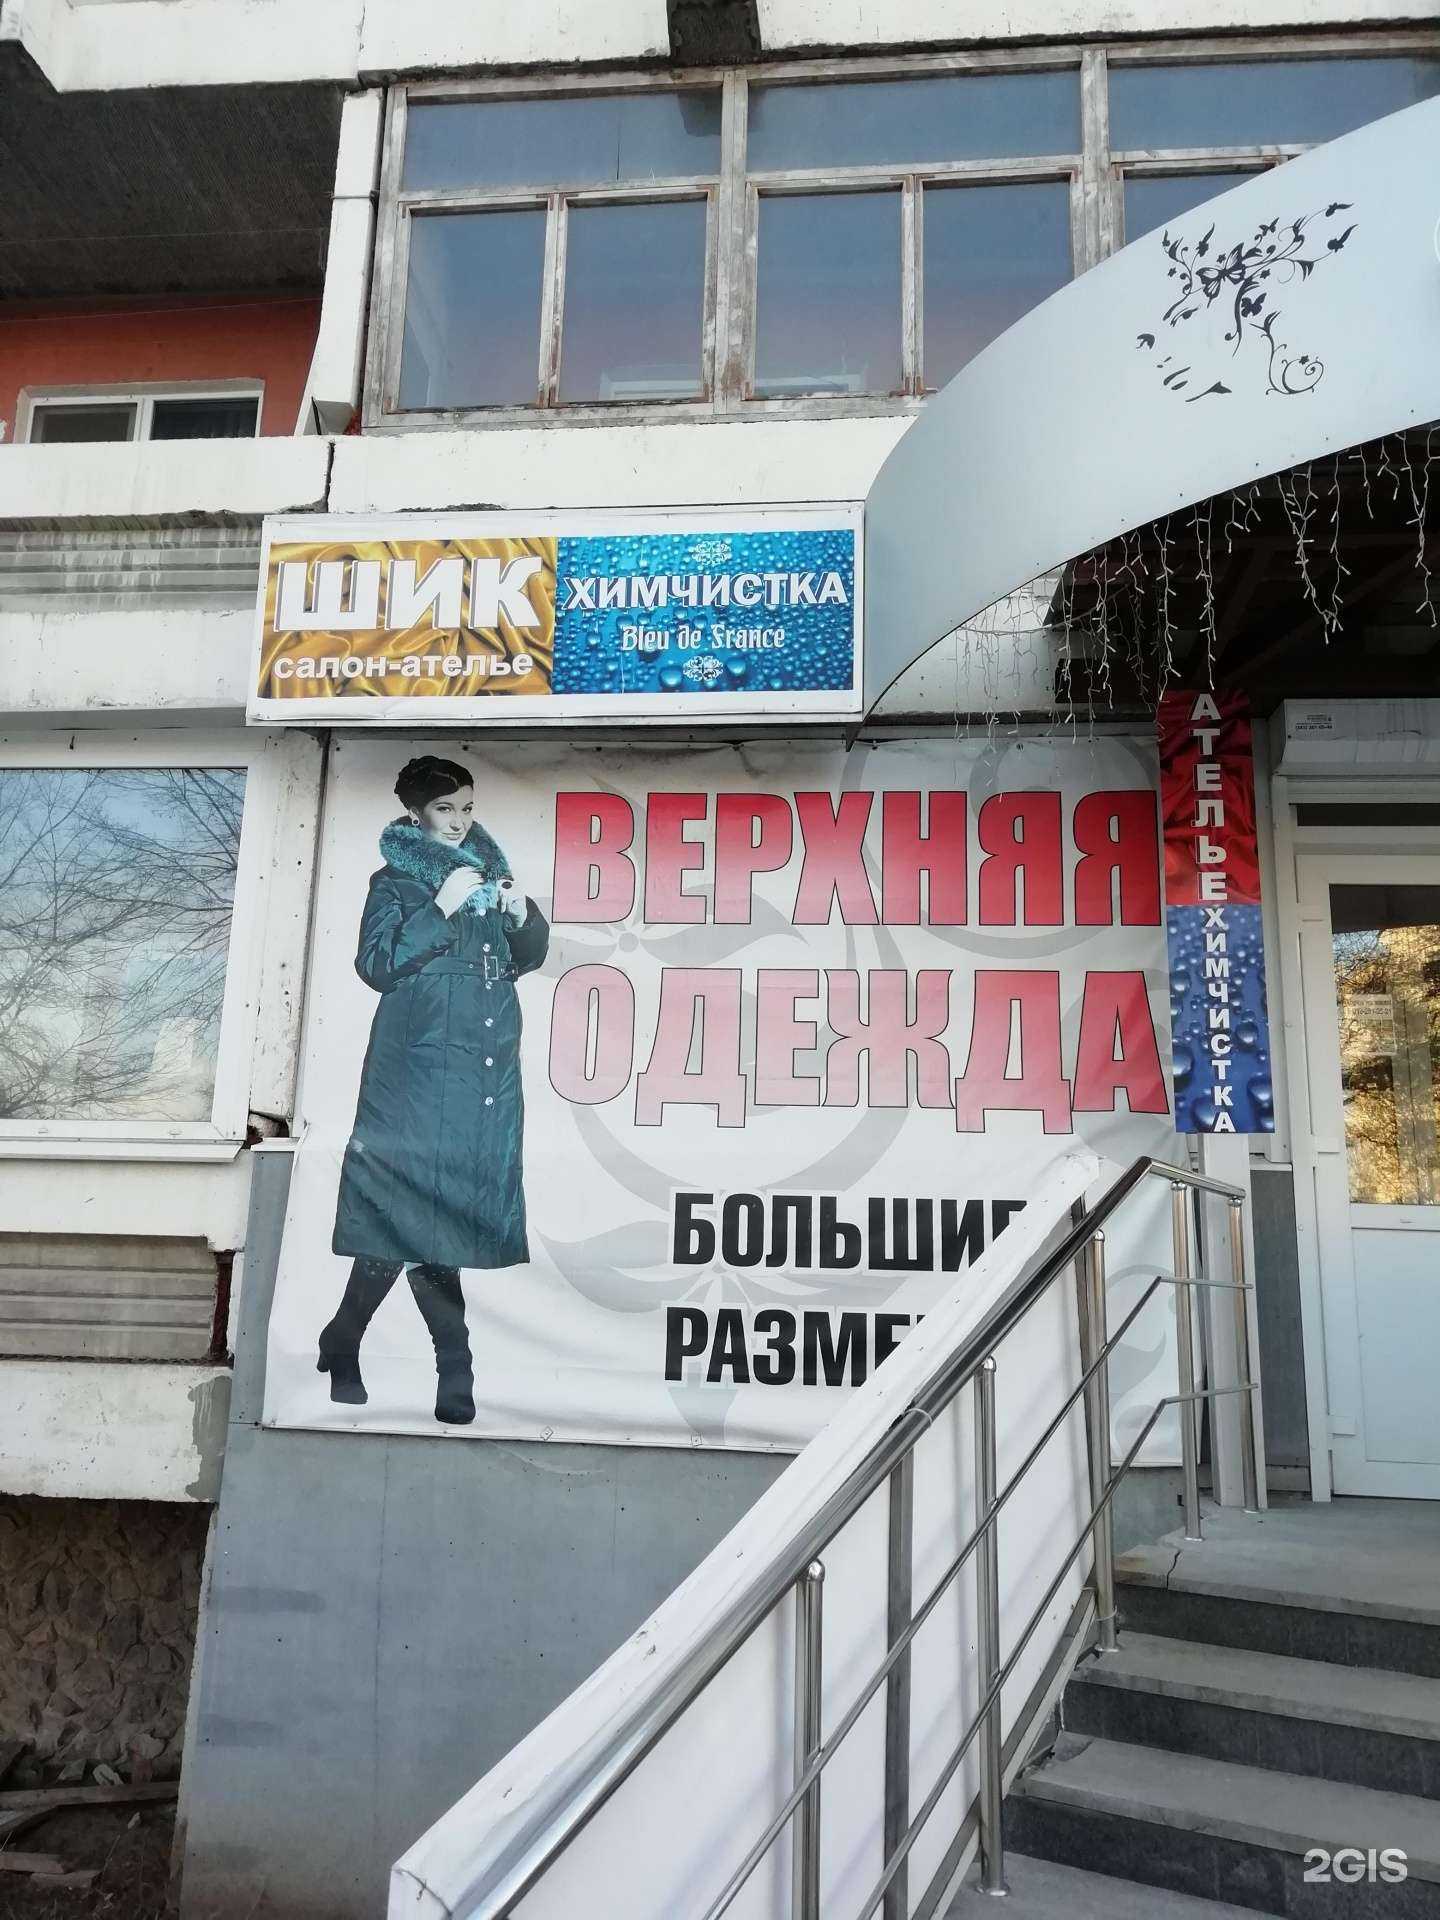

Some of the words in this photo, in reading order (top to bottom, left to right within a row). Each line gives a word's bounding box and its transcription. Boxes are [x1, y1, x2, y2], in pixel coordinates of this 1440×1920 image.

[273, 556, 544, 632] ШИК
[561, 571, 848, 611] ХИМЧИСТКА
[273, 653, 534, 679] салон-ателье
[622, 624, 670, 651] Bleu
[677, 624, 702, 650] de
[711, 623, 786, 650] France
[1190, 693, 1228, 901] АТЕЛЬЕ
[551, 790, 1162, 926] ВЕРХНЯЯ
[548, 963, 1170, 1134] ОДЕЖДА
[1205, 907, 1236, 1133] ХИМЧИСТКА
[664, 1306, 925, 1388] РАЗМЕ
